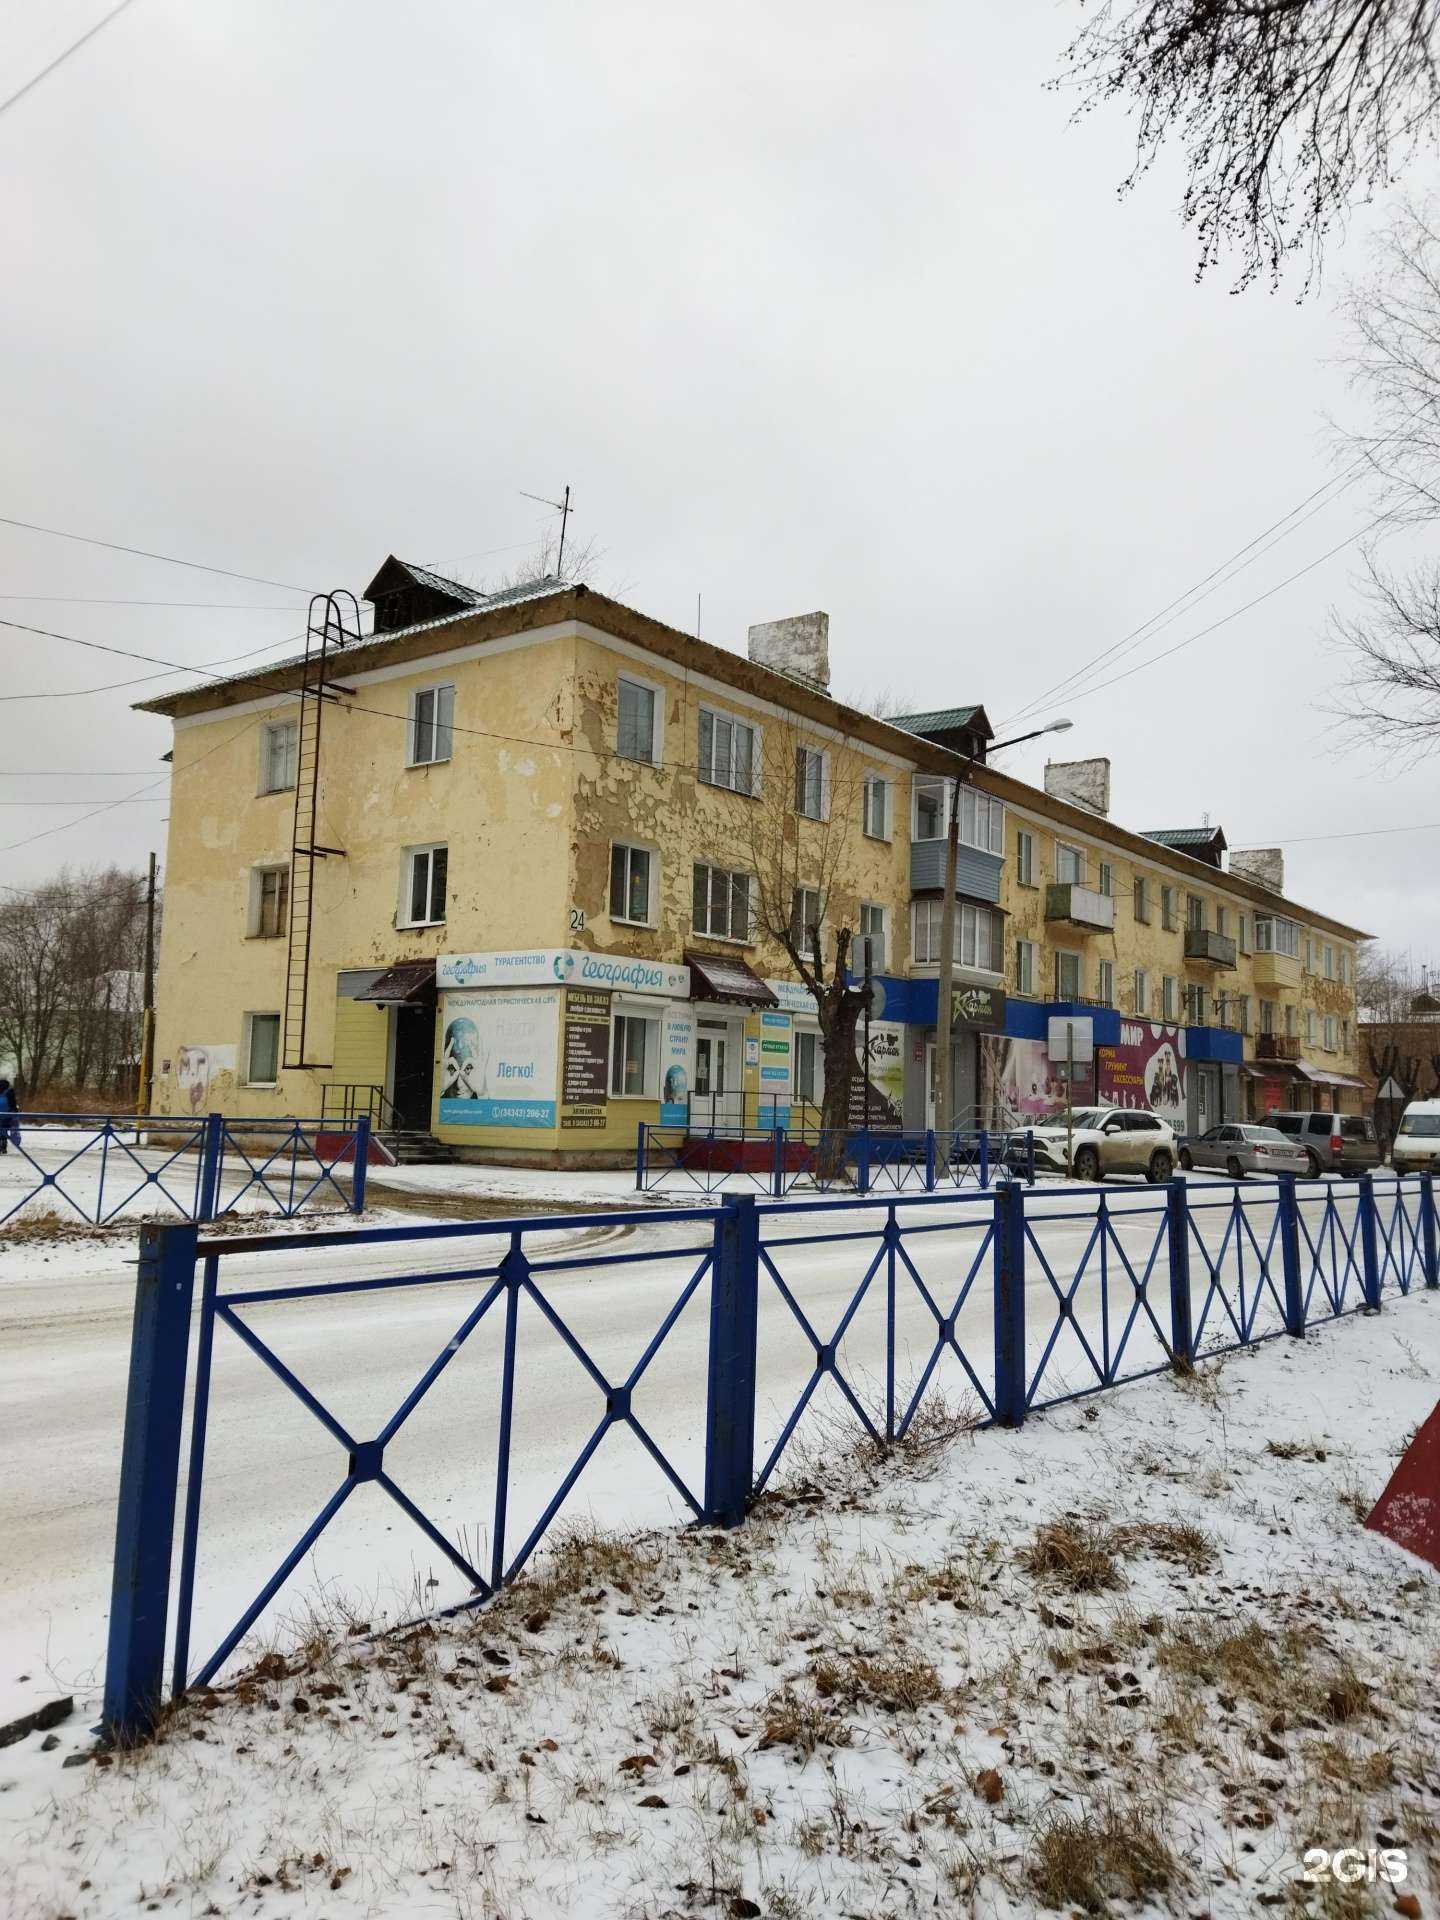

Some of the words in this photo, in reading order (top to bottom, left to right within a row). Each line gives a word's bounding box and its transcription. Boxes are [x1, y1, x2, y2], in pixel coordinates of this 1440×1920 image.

[570, 909, 584, 930] 24
[495, 955, 546, 967] ТУРАГЕНТСТВО
[1120, 1023, 1144, 1048] МИР
[671, 1047, 686, 1055] МИРА
[497, 1062, 534, 1078] Легко!
